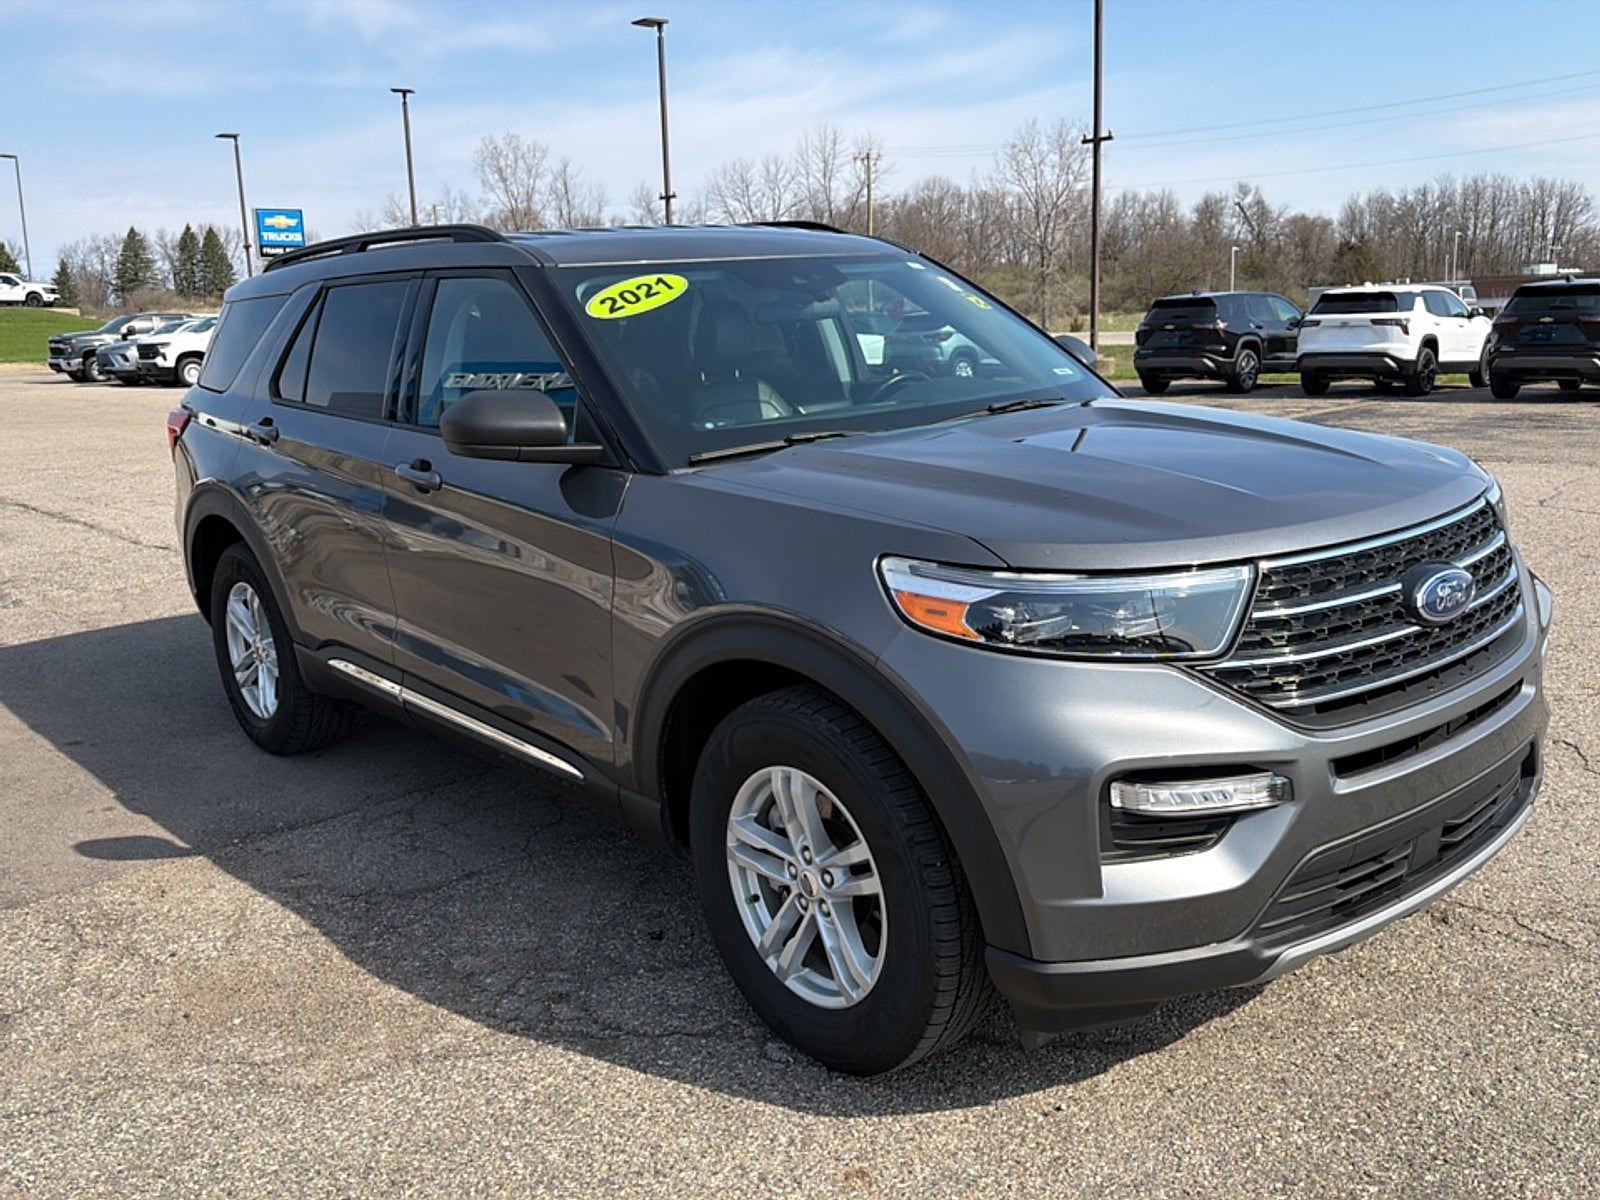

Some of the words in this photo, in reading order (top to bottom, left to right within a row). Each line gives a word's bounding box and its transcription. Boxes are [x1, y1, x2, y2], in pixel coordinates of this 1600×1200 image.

[261, 231, 303, 241] TRUCKS
[599, 276, 675, 314] 2021
[1436, 580, 1467, 611] Ford
